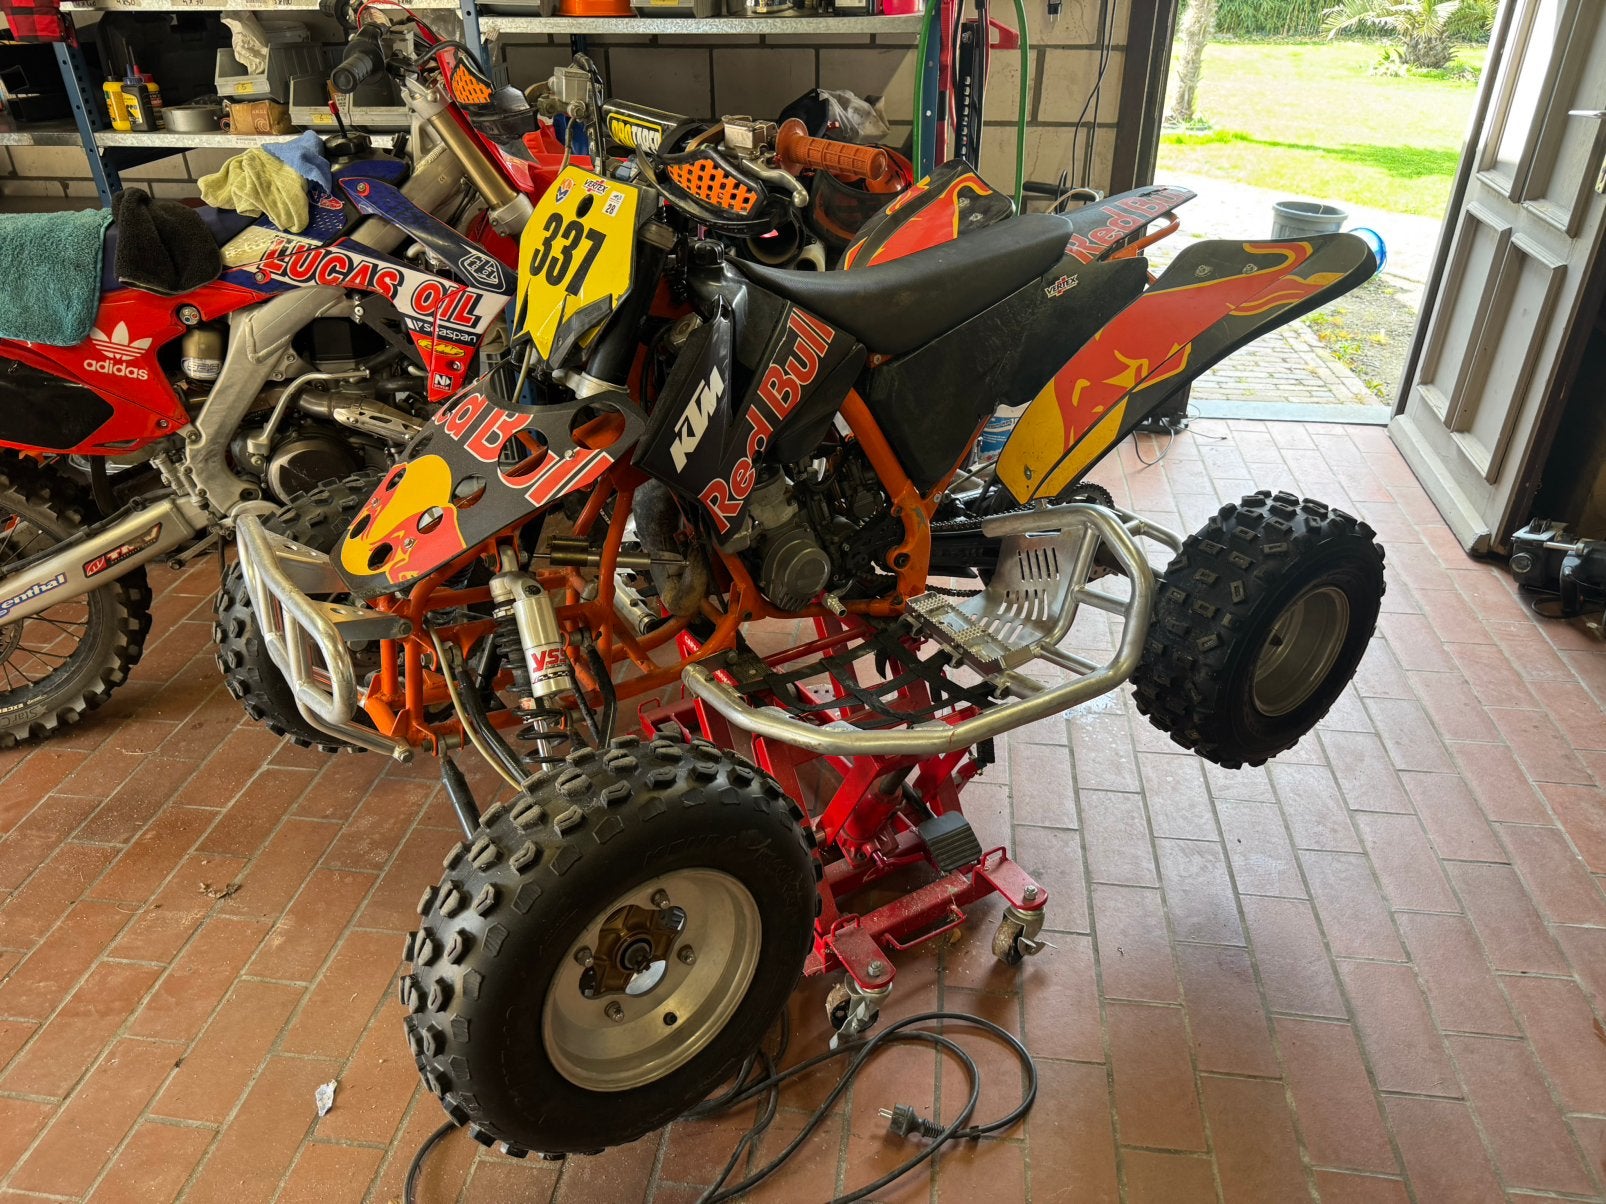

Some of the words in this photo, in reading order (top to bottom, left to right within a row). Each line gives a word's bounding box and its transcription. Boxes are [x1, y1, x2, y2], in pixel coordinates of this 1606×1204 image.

[605, 203, 616, 215] 28
[1065, 206, 1146, 265] Red
[258, 236, 403, 302] LUCAS
[411, 280, 483, 329] OIL
[529, 212, 607, 297] 337
[1045, 274, 1078, 297] VERTEX
[84, 358, 149, 380] adidas
[670, 365, 724, 474] KTM
[698, 404, 773, 535] Red
[757, 307, 835, 420] Bull
[0, 573, 66, 617] enthal
